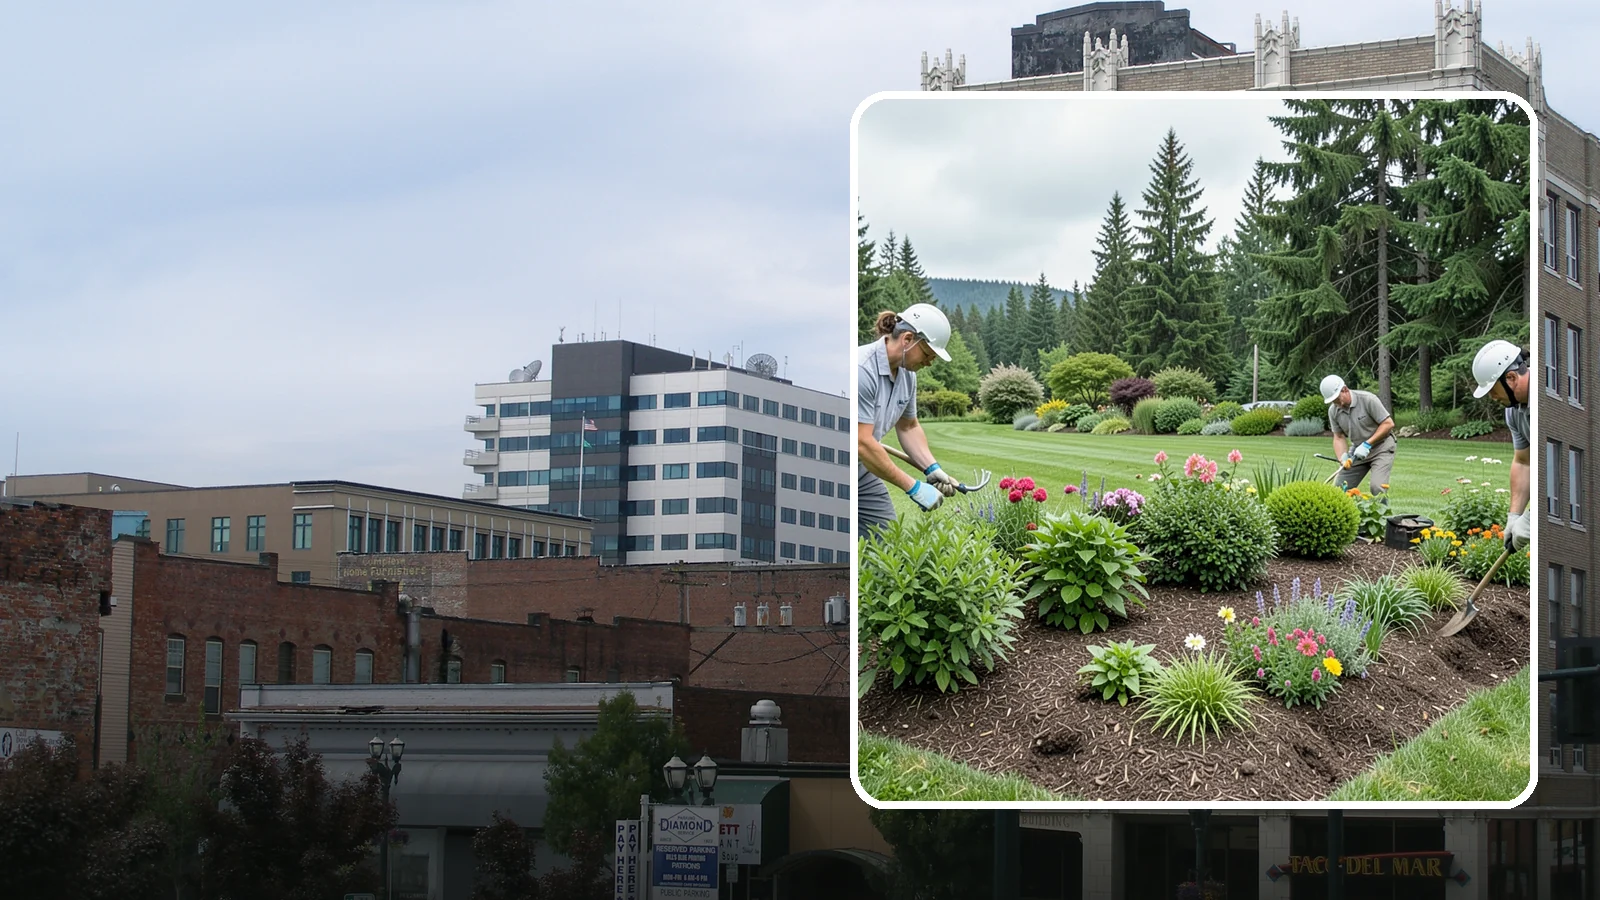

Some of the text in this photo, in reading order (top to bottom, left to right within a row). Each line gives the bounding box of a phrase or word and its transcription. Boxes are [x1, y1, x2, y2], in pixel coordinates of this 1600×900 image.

[343, 565, 427, 577] Home Furnishers
[660, 818, 713, 833] DIAMOND
[1022, 815, 1070, 828] BUILDING
[656, 845, 687, 853] RESERVED
[628, 825, 636, 893] PAY HERE
[722, 851, 739, 862] Soup
[1346, 856, 1385, 876] DEL
[1392, 857, 1442, 877] MAR
[660, 889, 710, 898] PUBLIC PARKING
